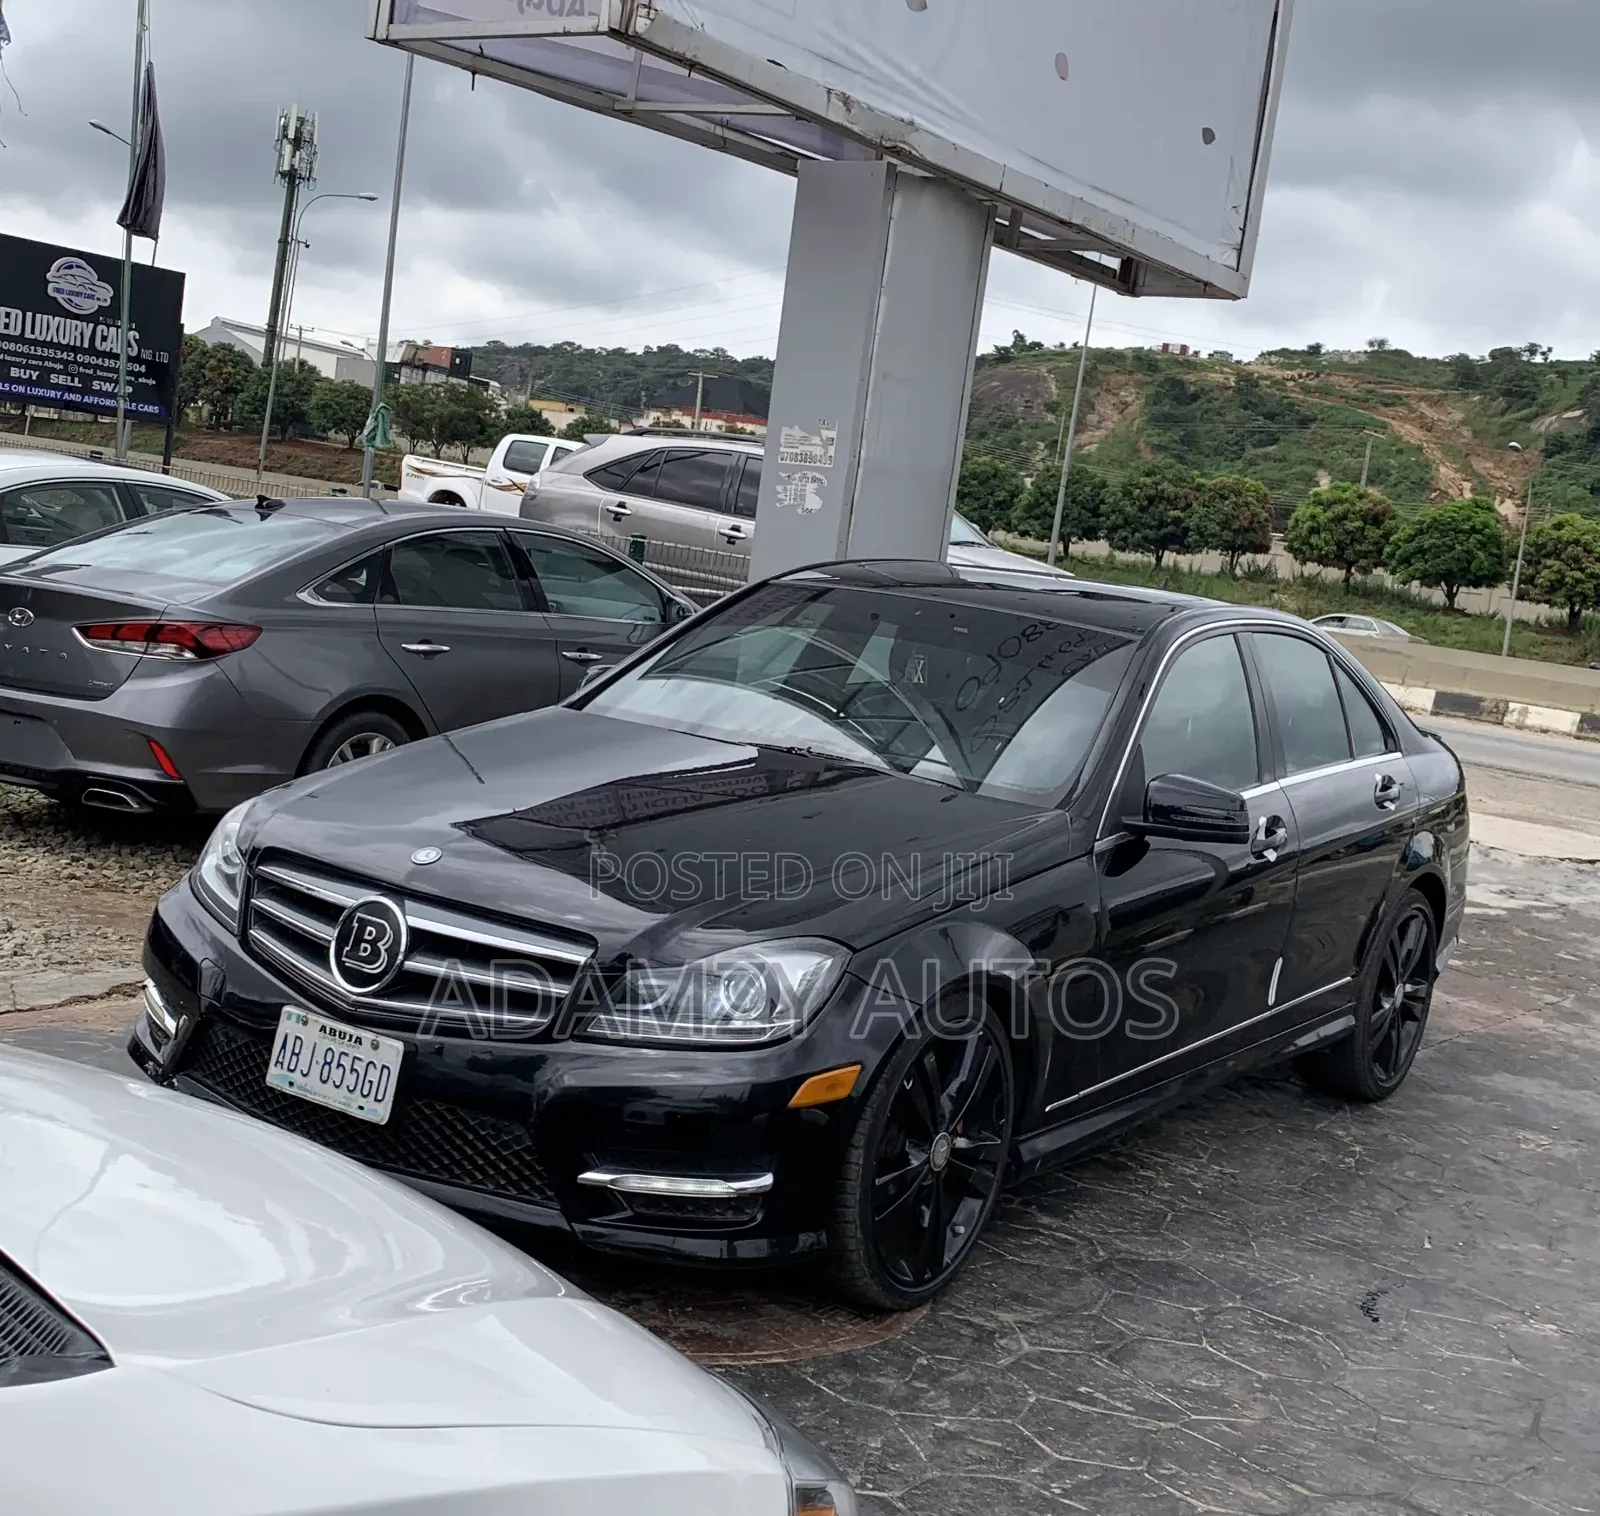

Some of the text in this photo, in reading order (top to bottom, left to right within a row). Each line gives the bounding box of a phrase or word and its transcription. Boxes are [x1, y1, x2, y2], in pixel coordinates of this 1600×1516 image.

[24, 311, 94, 348] LUXURY
[94, 324, 140, 357] CAS
[76, 353, 146, 373] 0904357504
[155, 351, 169, 363] LTD
[10, 367, 39, 380] BUY
[50, 373, 82, 387] SELL
[11, 384, 26, 394] ON
[27, 387, 62, 399] LUXURY
[63, 392, 82, 402] AND
[83, 395, 136, 410] AFFORDLE
[137, 403, 159, 414] CARS
[318, 1024, 363, 1046] ABUJA
